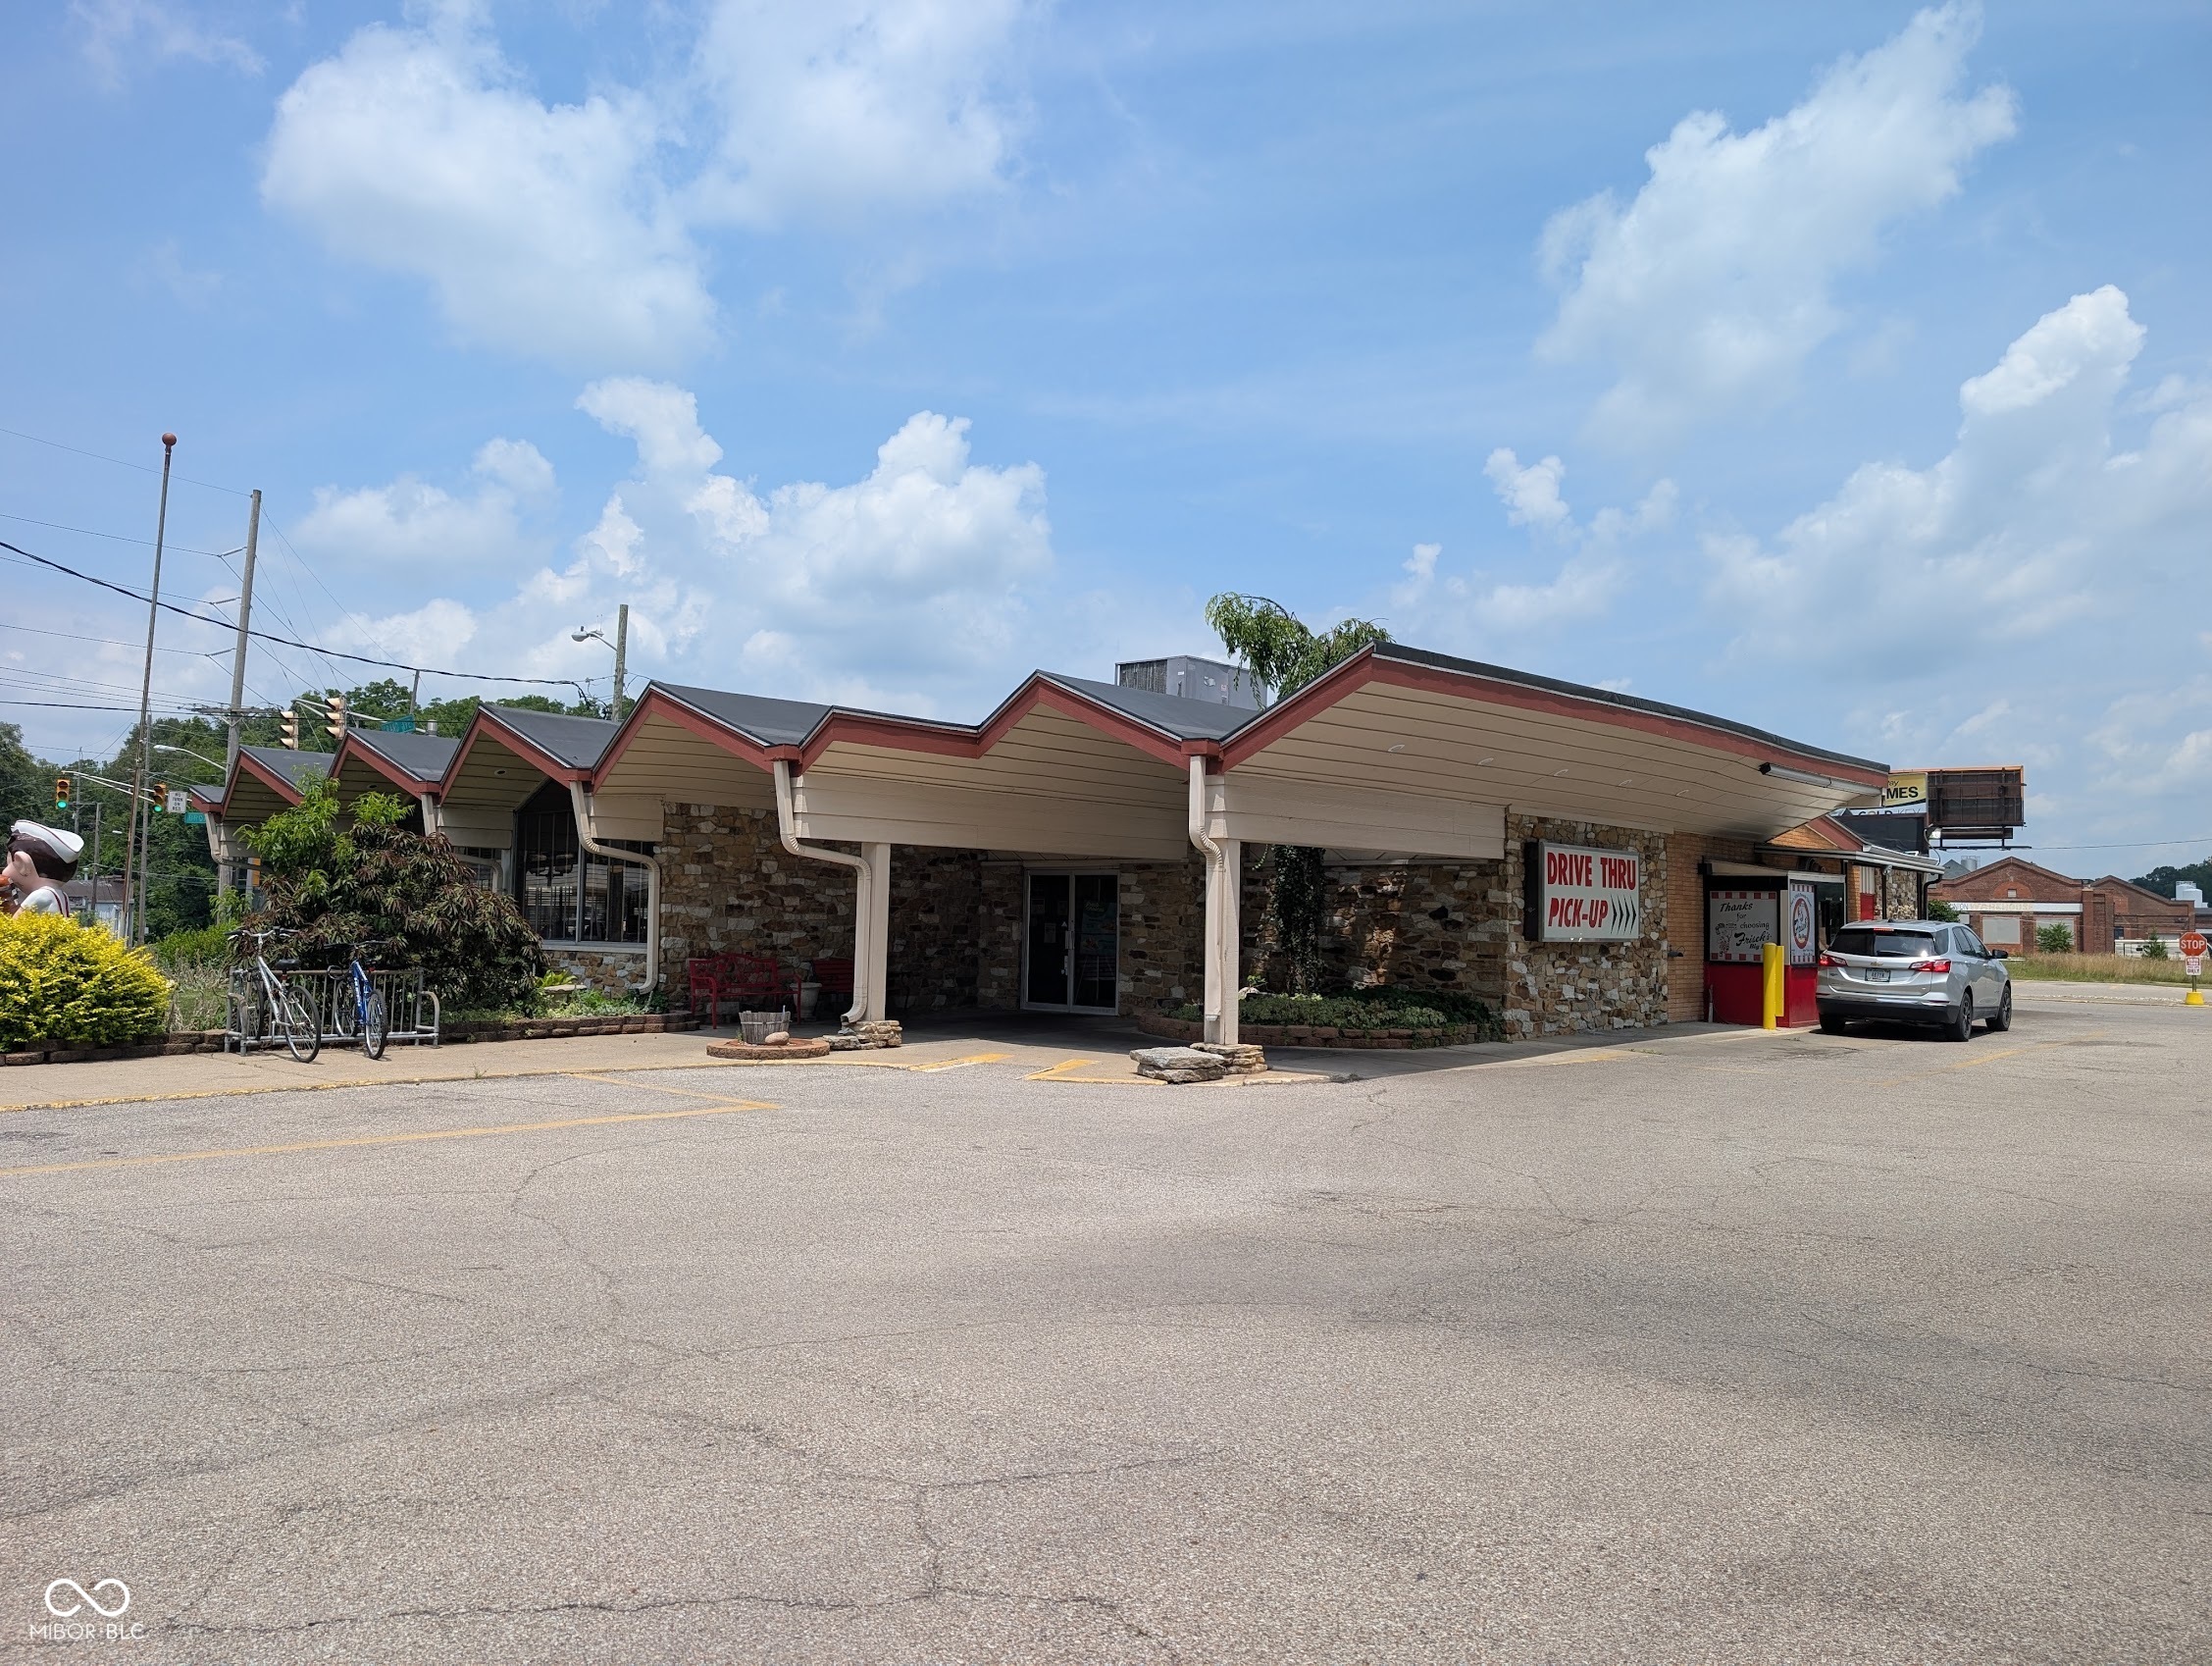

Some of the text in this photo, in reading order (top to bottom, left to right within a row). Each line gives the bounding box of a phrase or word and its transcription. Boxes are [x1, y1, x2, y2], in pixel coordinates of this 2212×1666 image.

[1547, 852, 1636, 890] DRIVE THRU
[1720, 902, 1753, 912] Thanks
[1548, 897, 1609, 928] PICK-UP
[1736, 912, 1746, 921] for
[1740, 921, 1770, 930] choosing
[2181, 940, 2205, 950] STOP
